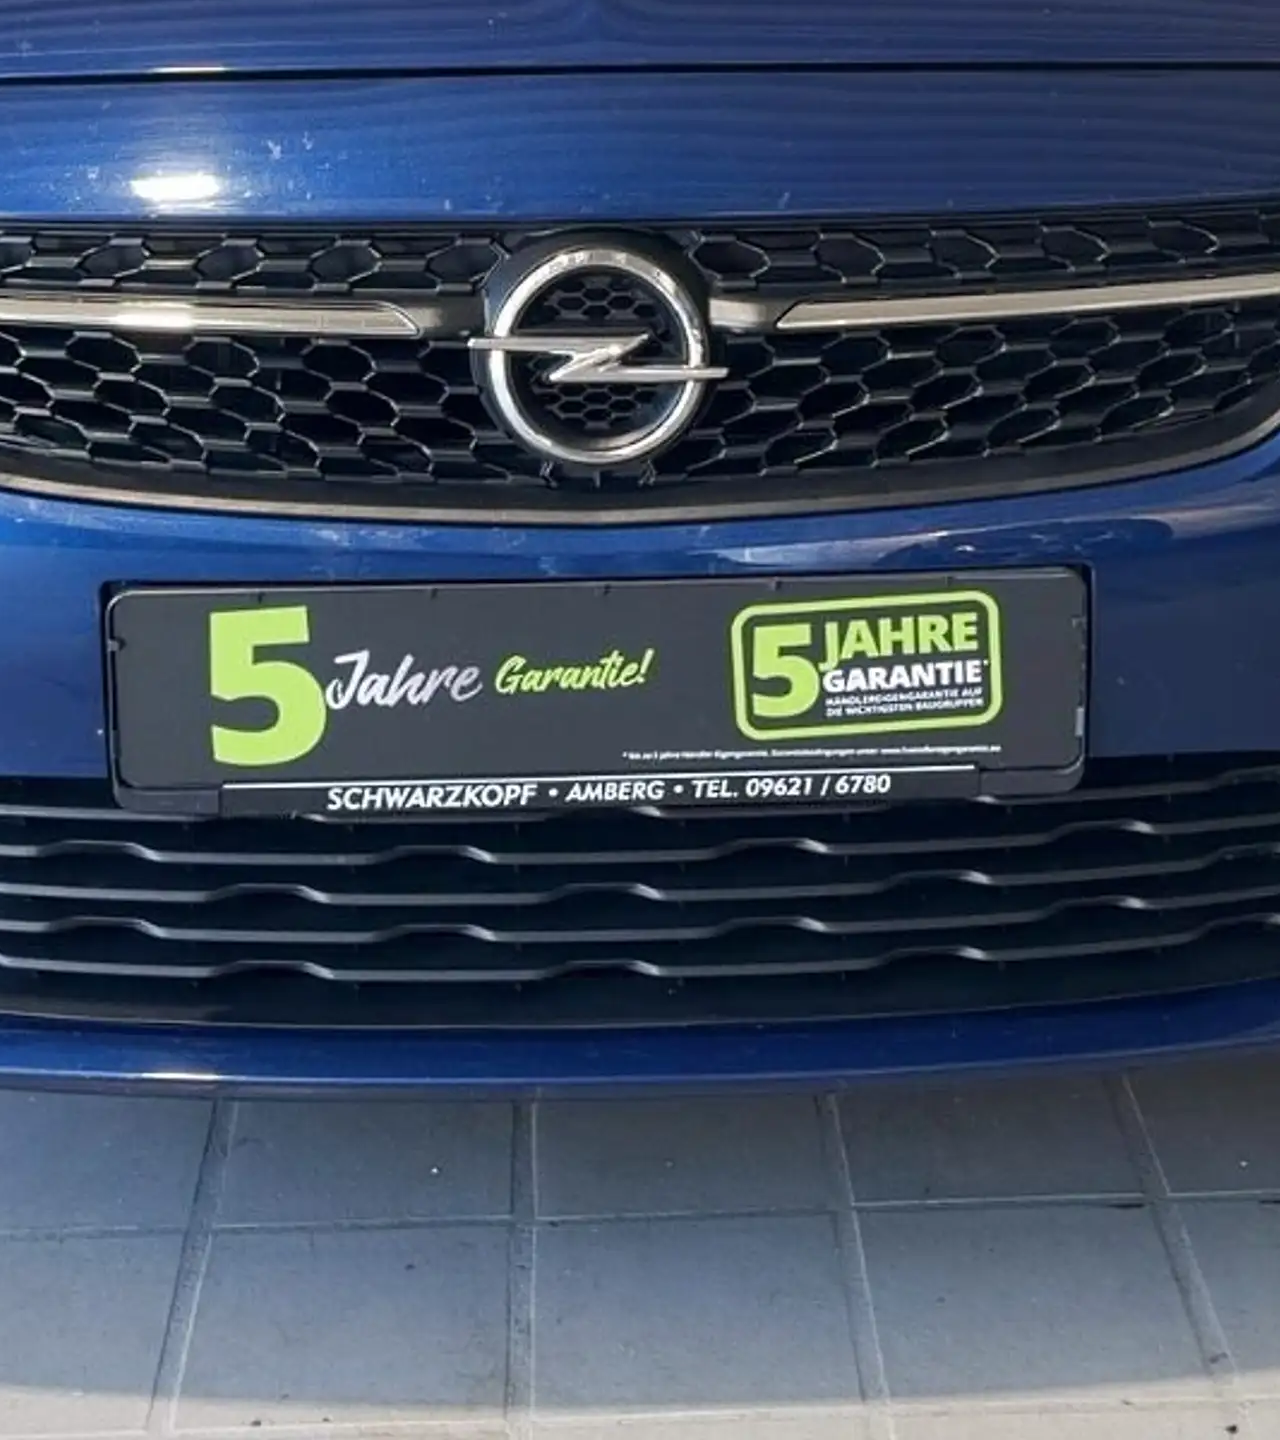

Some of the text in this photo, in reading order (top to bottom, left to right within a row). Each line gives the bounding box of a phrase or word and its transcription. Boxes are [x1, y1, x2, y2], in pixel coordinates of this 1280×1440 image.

[752, 623, 819, 718] 5
[818, 612, 979, 671] JAHRE
[209, 605, 655, 766] 5 Jahre Garantie!
[326, 784, 538, 811] SCHWARZKOPF
[565, 779, 665, 802] AMBERG
[691, 778, 738, 800] TEL.
[745, 776, 813, 798] 09621
[834, 774, 892, 795] 6780
